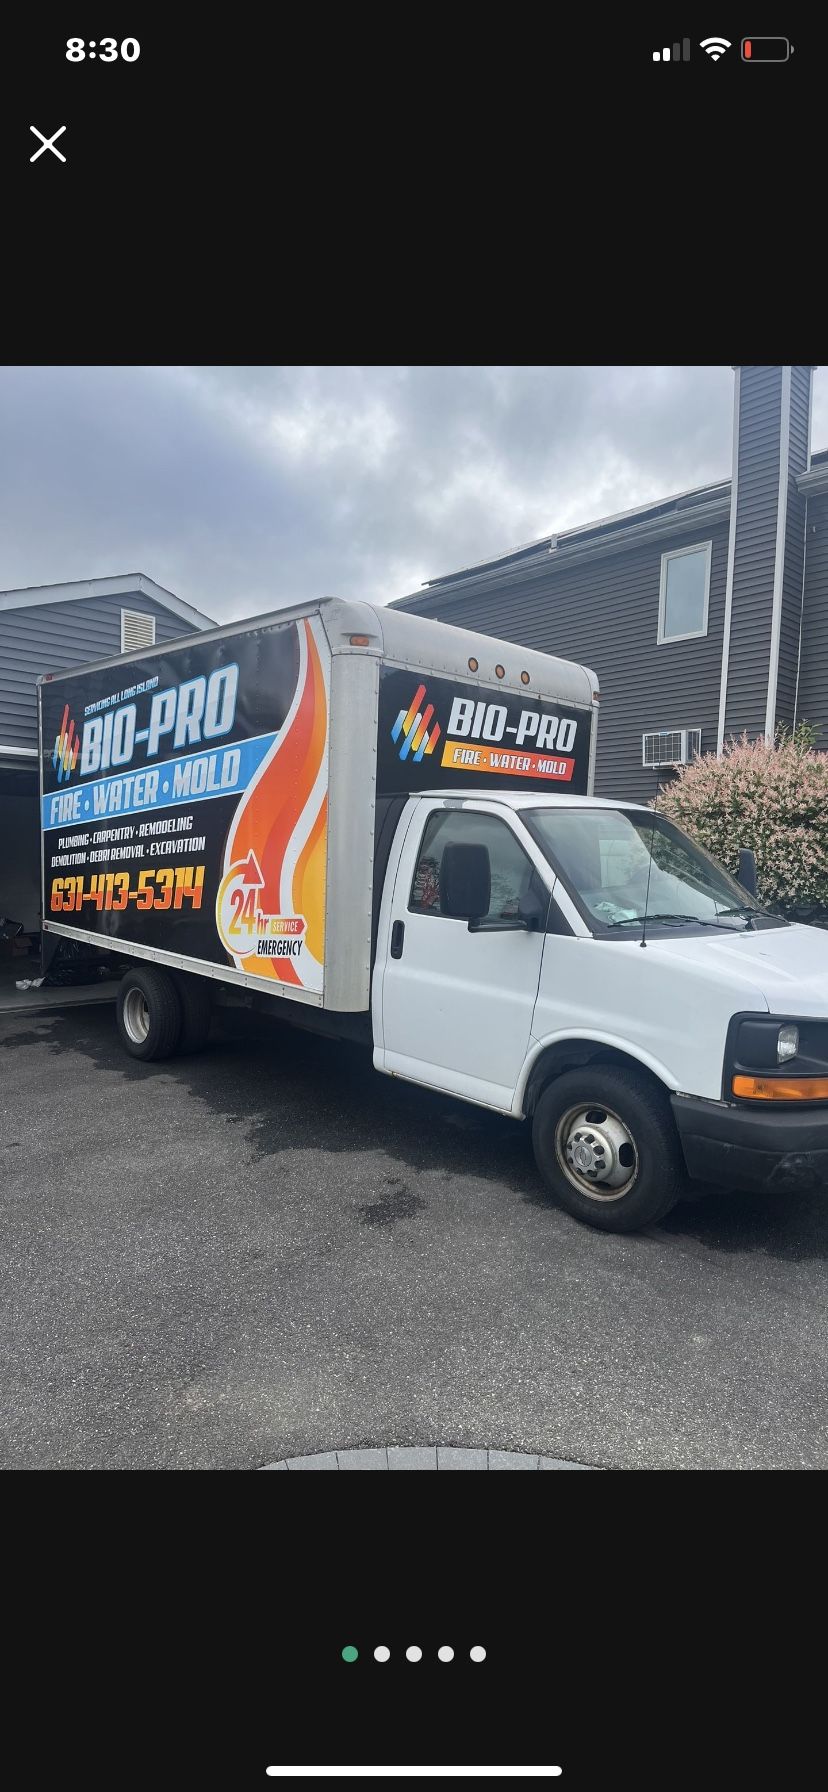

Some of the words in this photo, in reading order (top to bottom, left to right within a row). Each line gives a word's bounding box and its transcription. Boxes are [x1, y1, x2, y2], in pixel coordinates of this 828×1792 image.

[111, 692, 120, 705] ALL
[120, 685, 136, 701] LONG
[136, 676, 159, 694] ISLAND
[80, 663, 239, 776] BIO-PRO
[447, 697, 577, 752] BIO-PRO
[453, 748, 481, 765] FIRE
[490, 753, 530, 771] WATER
[536, 759, 566, 775] MOLD
[50, 789, 81, 825] FIRE
[93, 770, 160, 815] WATER
[172, 749, 241, 799] MOLD
[58, 833, 90, 849] PLUMBING
[93, 826, 135, 844] CARPENTRY
[139, 816, 193, 837] REMODELING
[51, 855, 87, 867] DEMOLITION
[90, 849, 111, 863] DEBRI
[111, 845, 145, 860] REMOVAL
[150, 836, 206, 856] EXCAVATION
[51, 866, 206, 911] 631-413-5314
[272, 921, 298, 932] SERVICE
[257, 940, 303, 956] EMERGENCY
